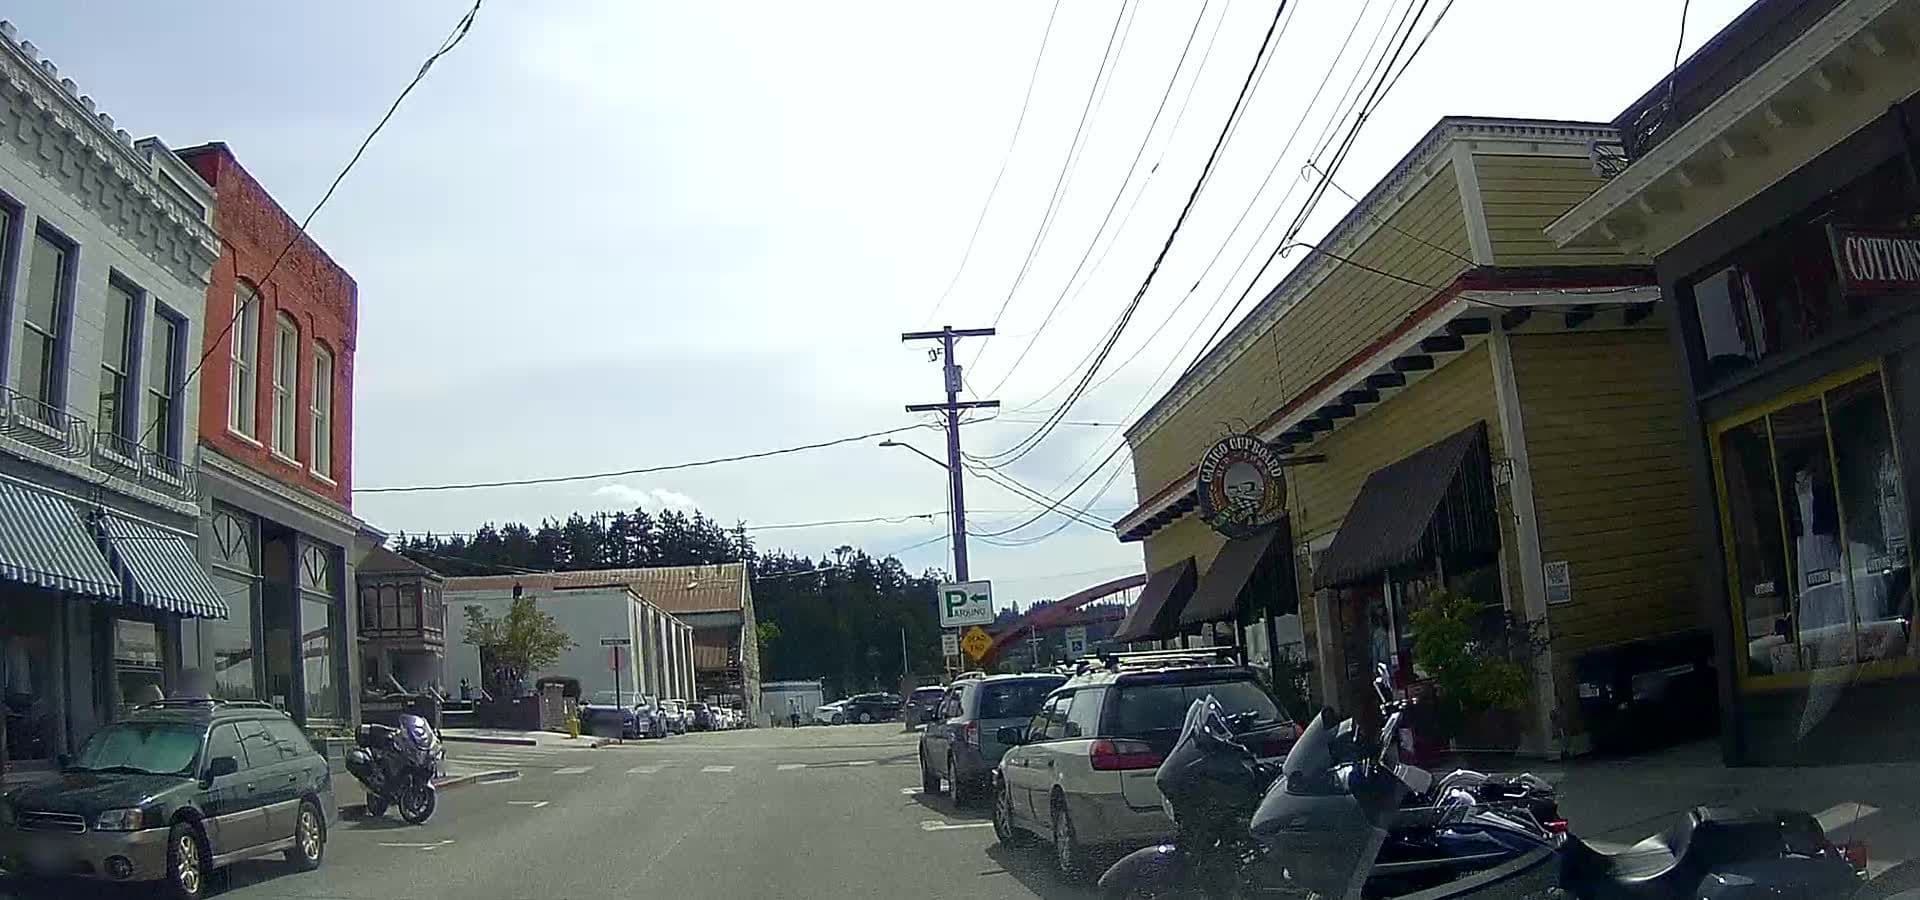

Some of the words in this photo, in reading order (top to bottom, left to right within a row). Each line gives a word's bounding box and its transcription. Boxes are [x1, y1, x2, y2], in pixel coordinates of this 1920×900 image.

[1201, 443, 1228, 483] CALICO
[1229, 437, 1283, 478] CUPBOARD
[945, 591, 986, 618] PARKING
